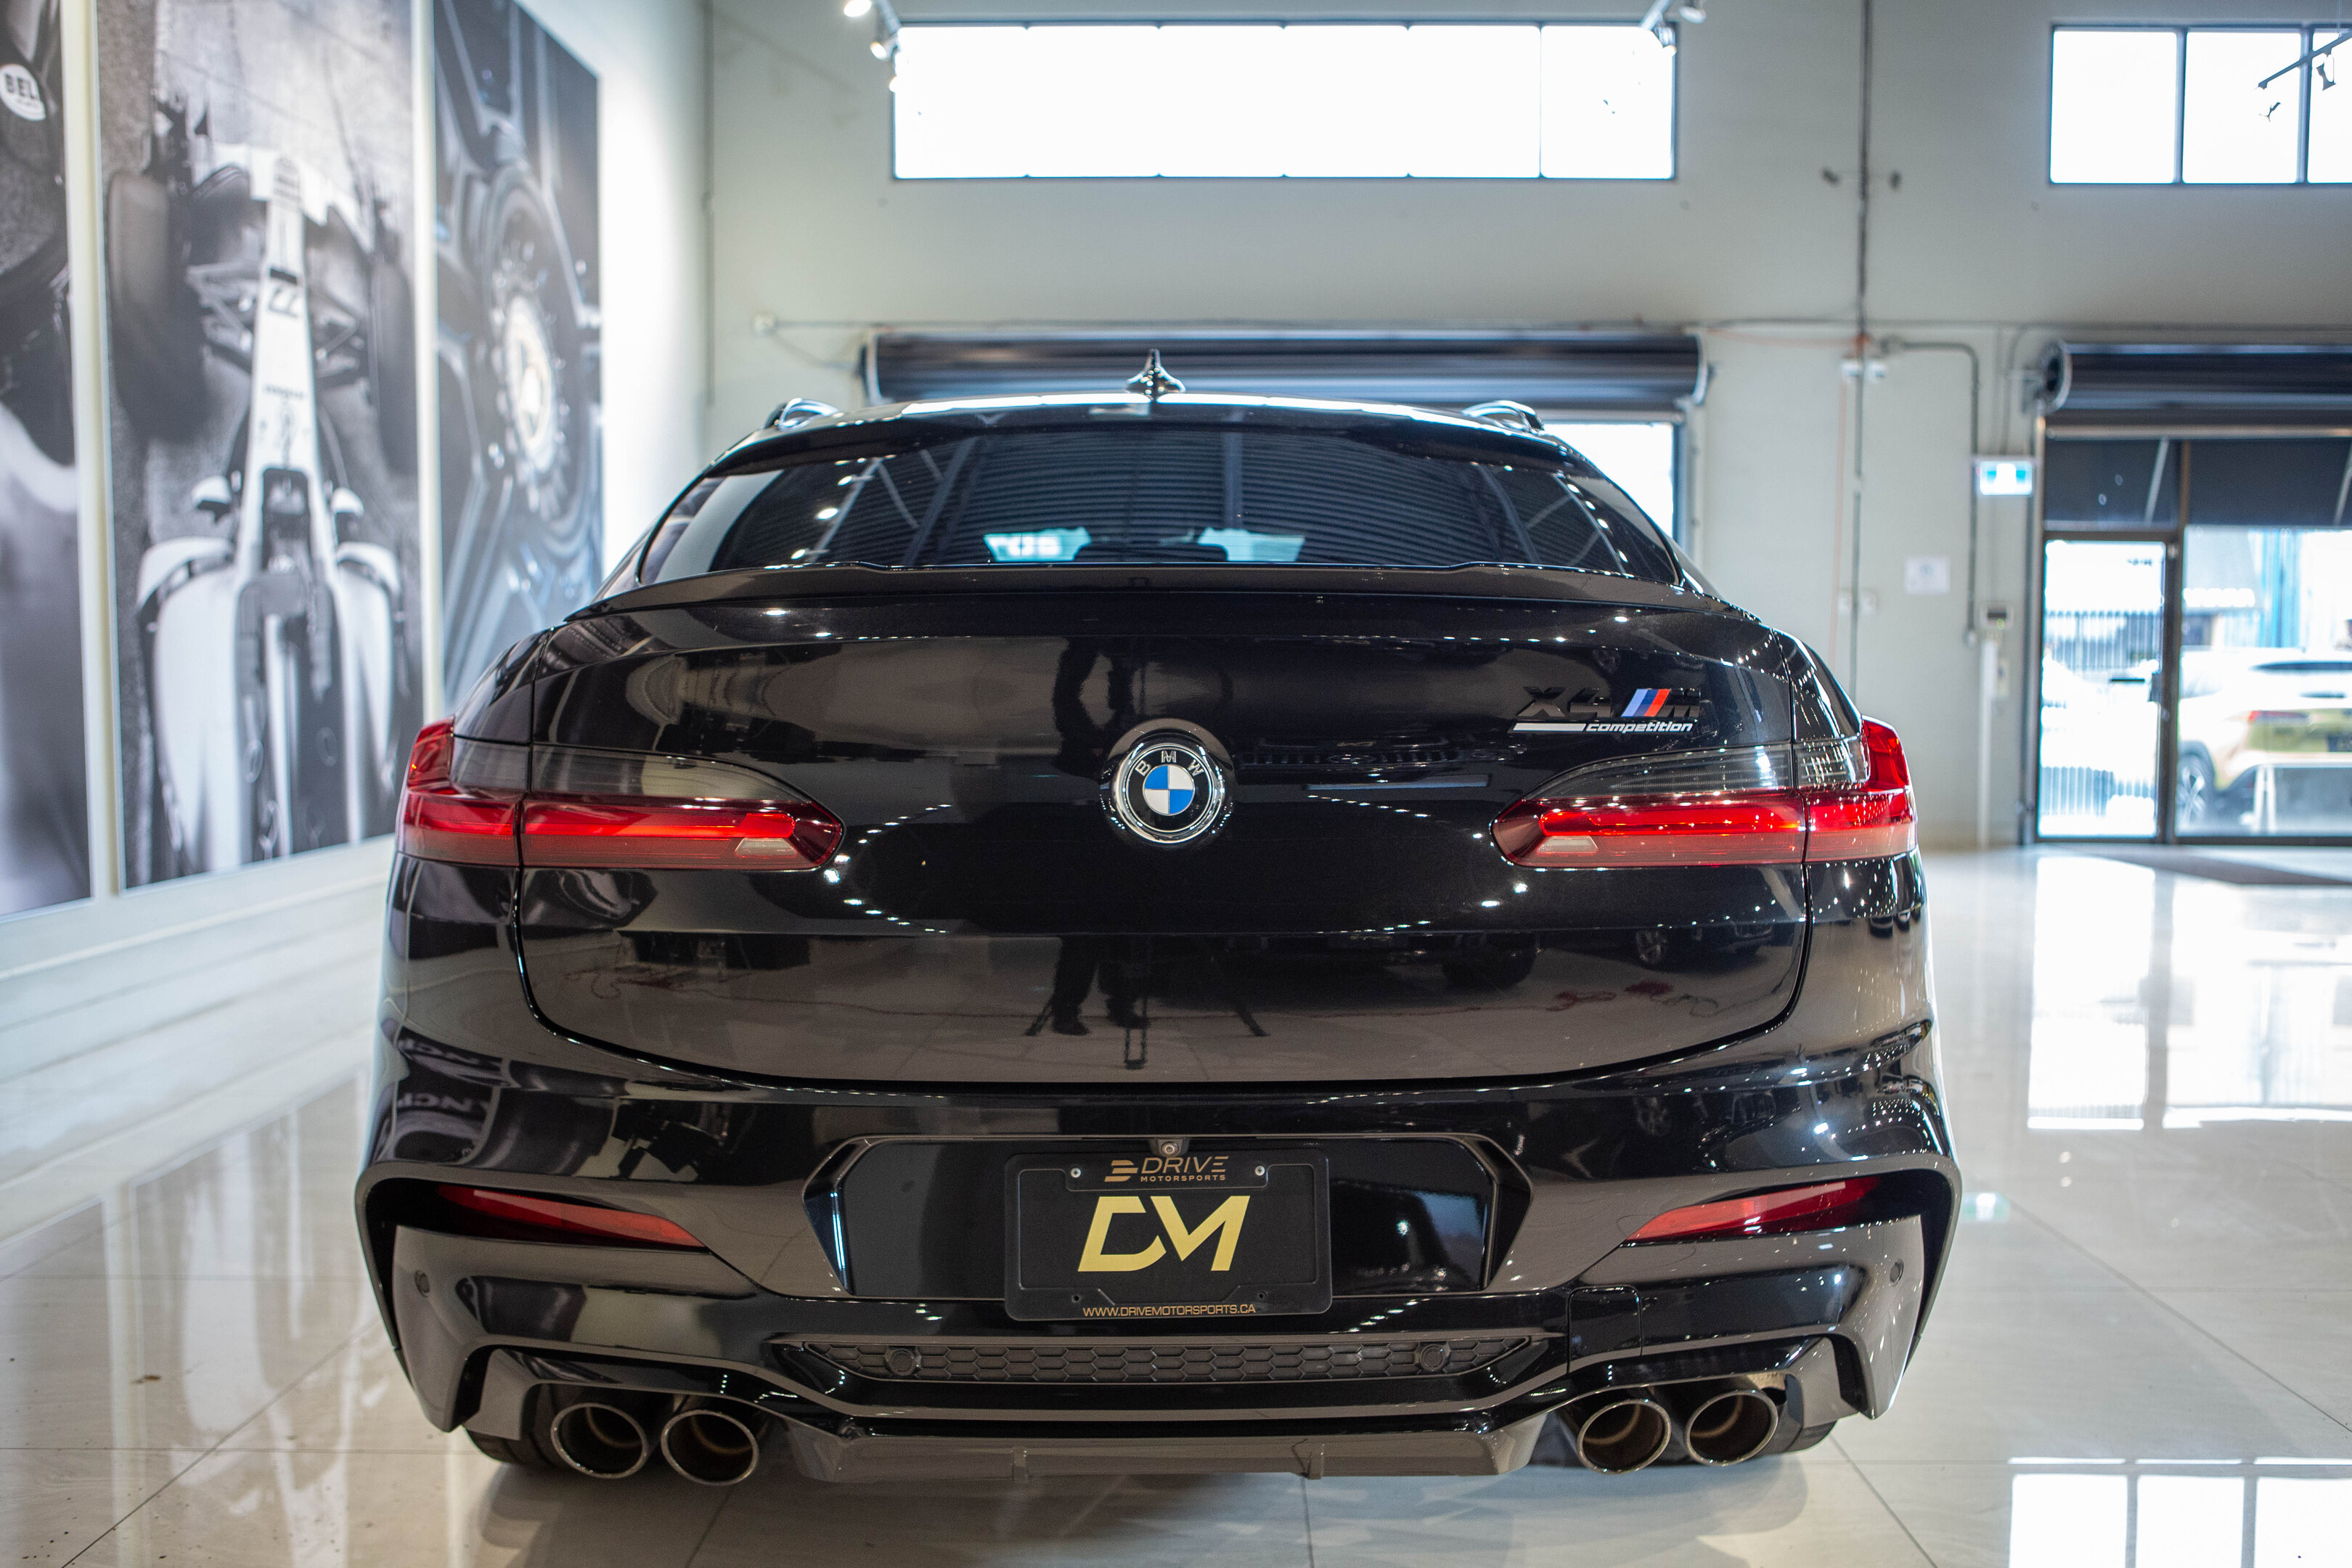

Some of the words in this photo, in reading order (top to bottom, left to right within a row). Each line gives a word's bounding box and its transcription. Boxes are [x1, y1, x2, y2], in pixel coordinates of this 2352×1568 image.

[1516, 686, 1612, 717] X4
[1585, 721, 1694, 734] competition
[1134, 750, 1204, 777] BMW
[1140, 1156, 1229, 1175] DRIVE
[1140, 1174, 1226, 1183] MOTORSPORTS
[1082, 1304, 1257, 1317] WWW.DRIVEMOTORSPORTS.CA
